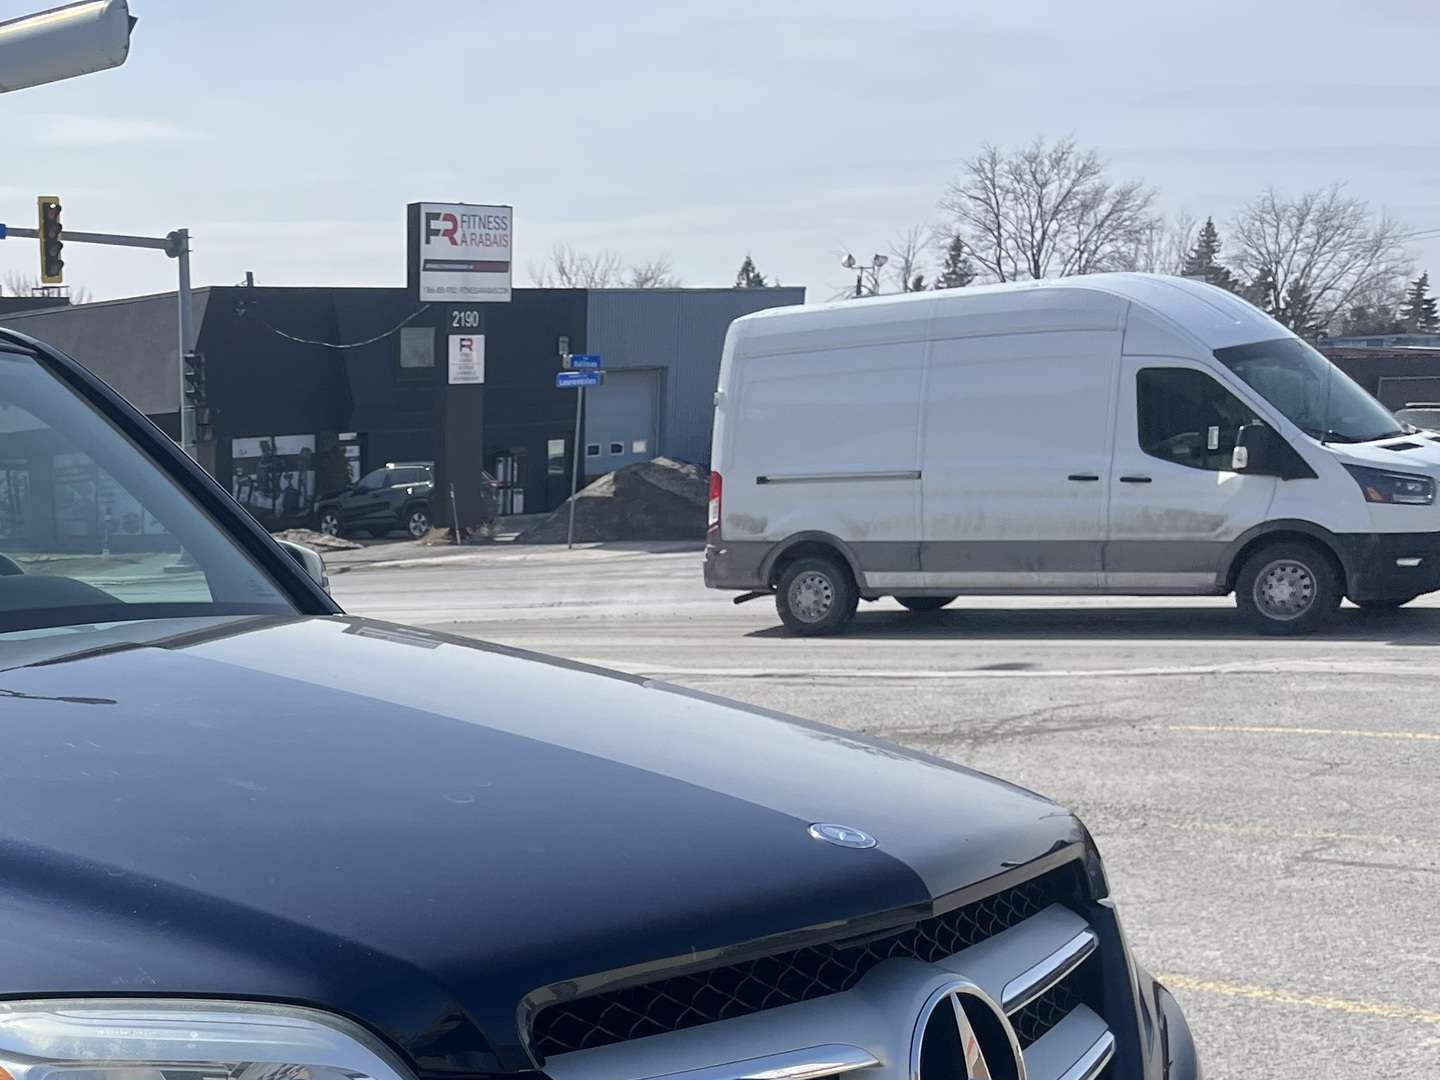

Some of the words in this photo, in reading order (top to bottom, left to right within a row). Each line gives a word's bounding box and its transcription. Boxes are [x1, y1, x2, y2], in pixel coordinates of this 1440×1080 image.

[461, 214, 508, 231] FITNESS
[471, 232, 509, 248] RABAIS
[452, 311, 479, 327] 2190
